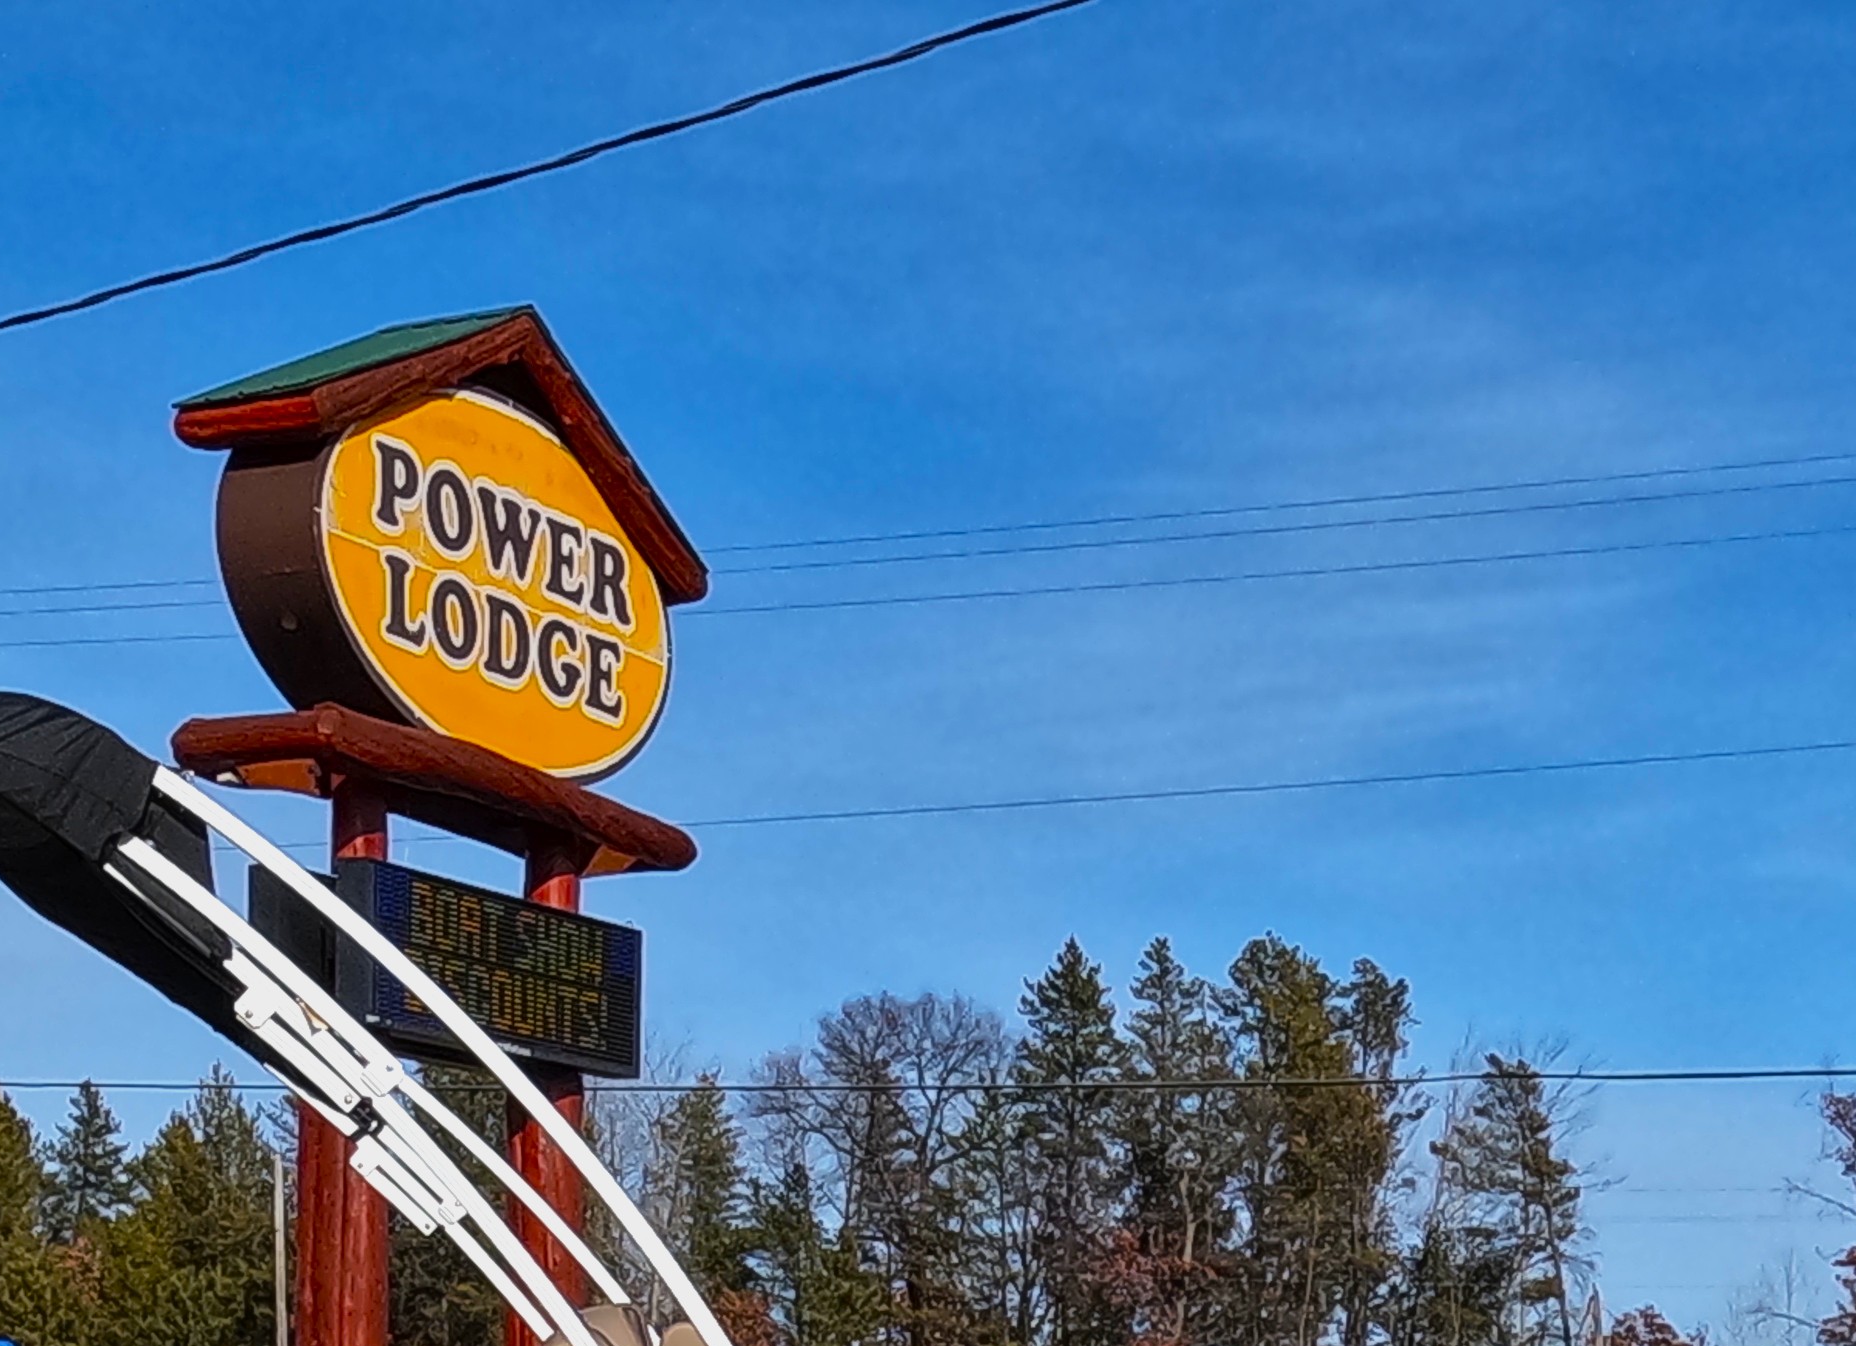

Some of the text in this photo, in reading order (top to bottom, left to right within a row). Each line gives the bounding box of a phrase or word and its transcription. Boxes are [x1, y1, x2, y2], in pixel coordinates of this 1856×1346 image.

[375, 438, 632, 627] POWER
[385, 553, 626, 719] LODGE
[410, 881, 604, 987] BOAT SHOW
